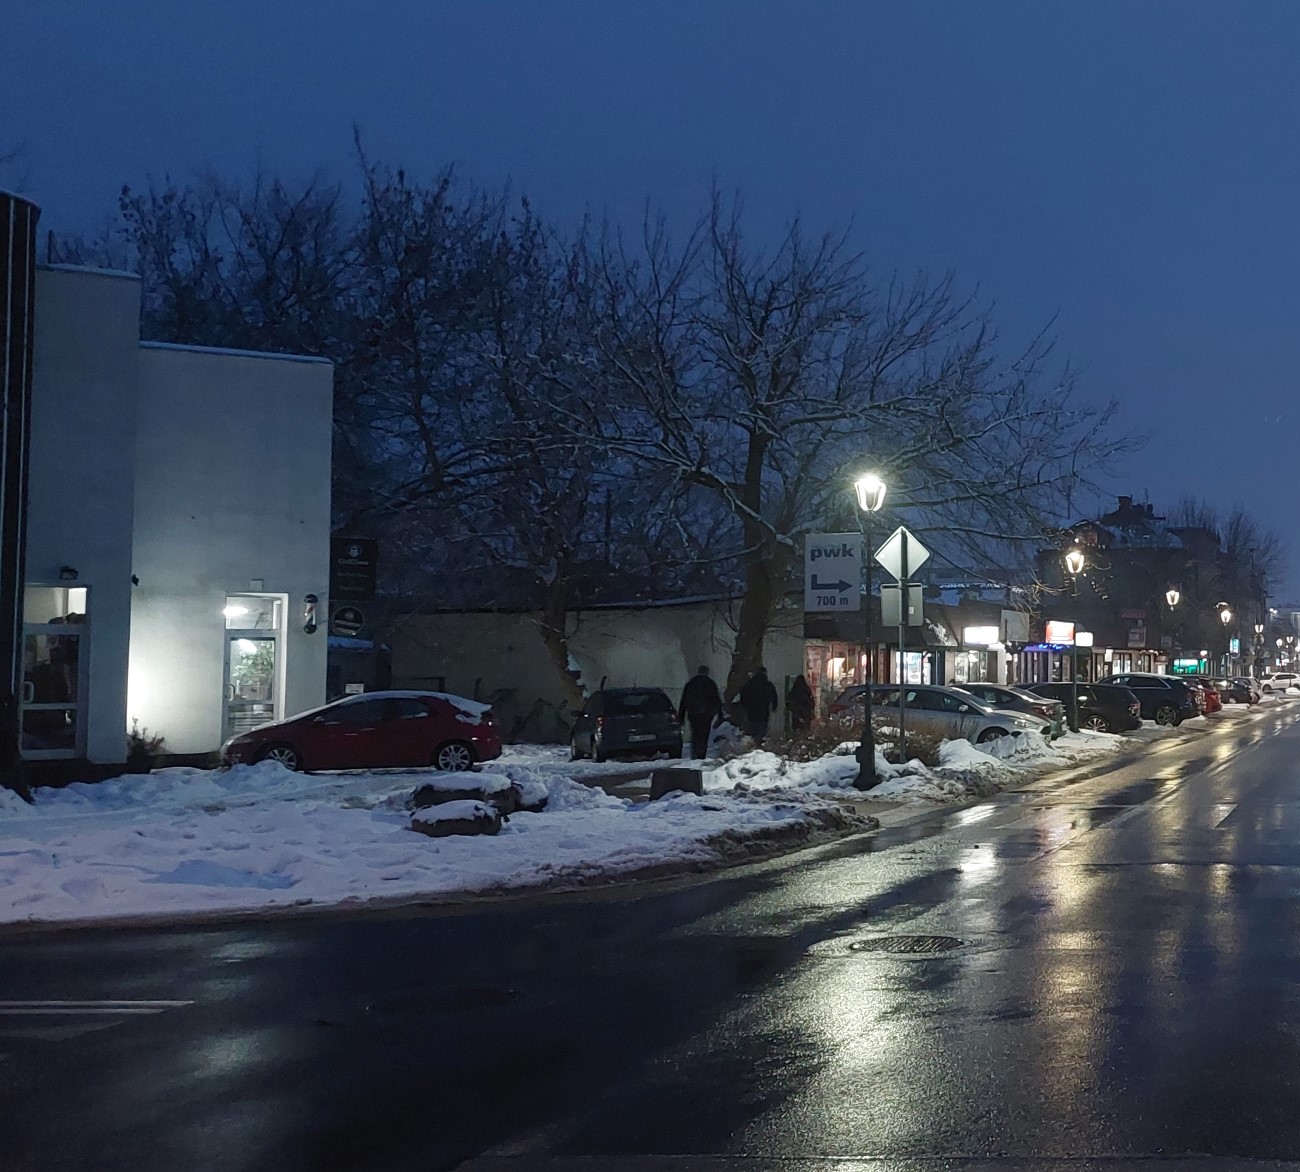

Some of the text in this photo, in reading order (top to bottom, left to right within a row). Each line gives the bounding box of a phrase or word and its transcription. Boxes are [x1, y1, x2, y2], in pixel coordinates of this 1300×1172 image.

[810, 543, 854, 561] pwk
[816, 596, 848, 606] 700 m
